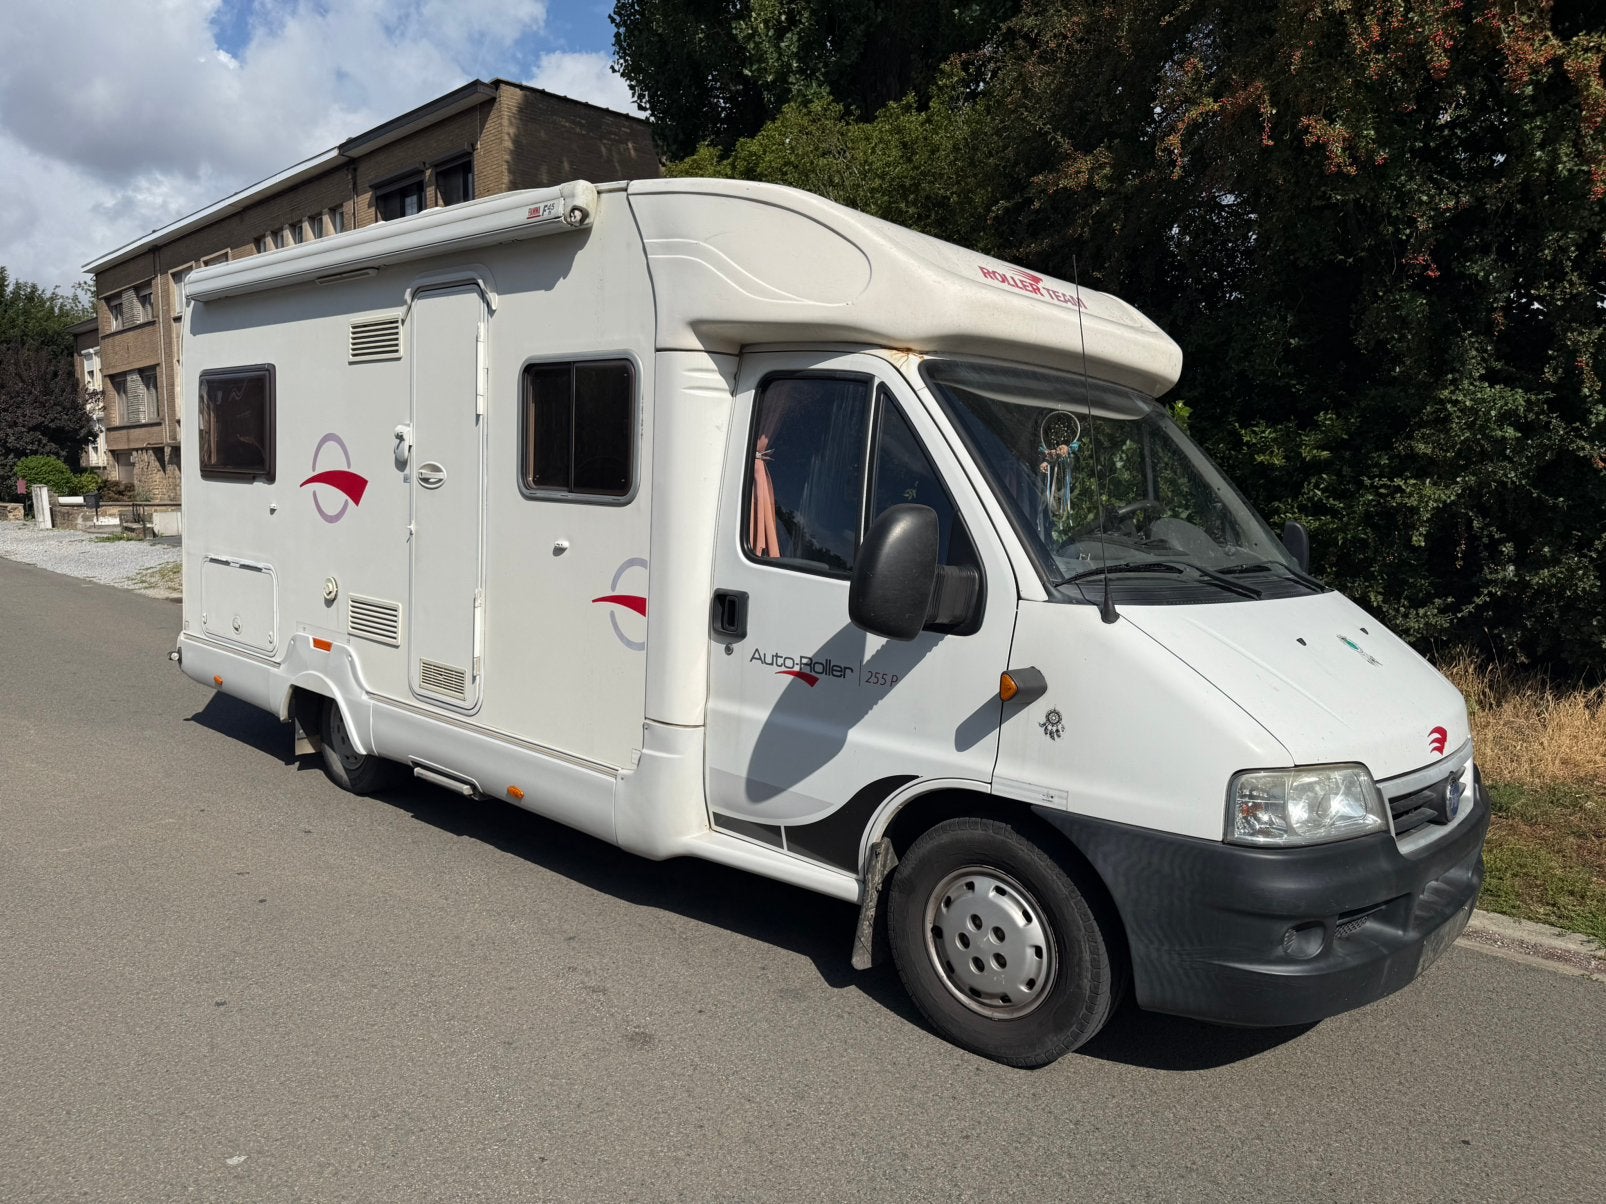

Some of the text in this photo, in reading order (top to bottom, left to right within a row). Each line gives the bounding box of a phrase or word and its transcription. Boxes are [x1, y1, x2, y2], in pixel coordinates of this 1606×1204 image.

[978, 265, 1088, 310] ROLLER TEAM
[749, 647, 899, 687] Auto-Roller 255 P
